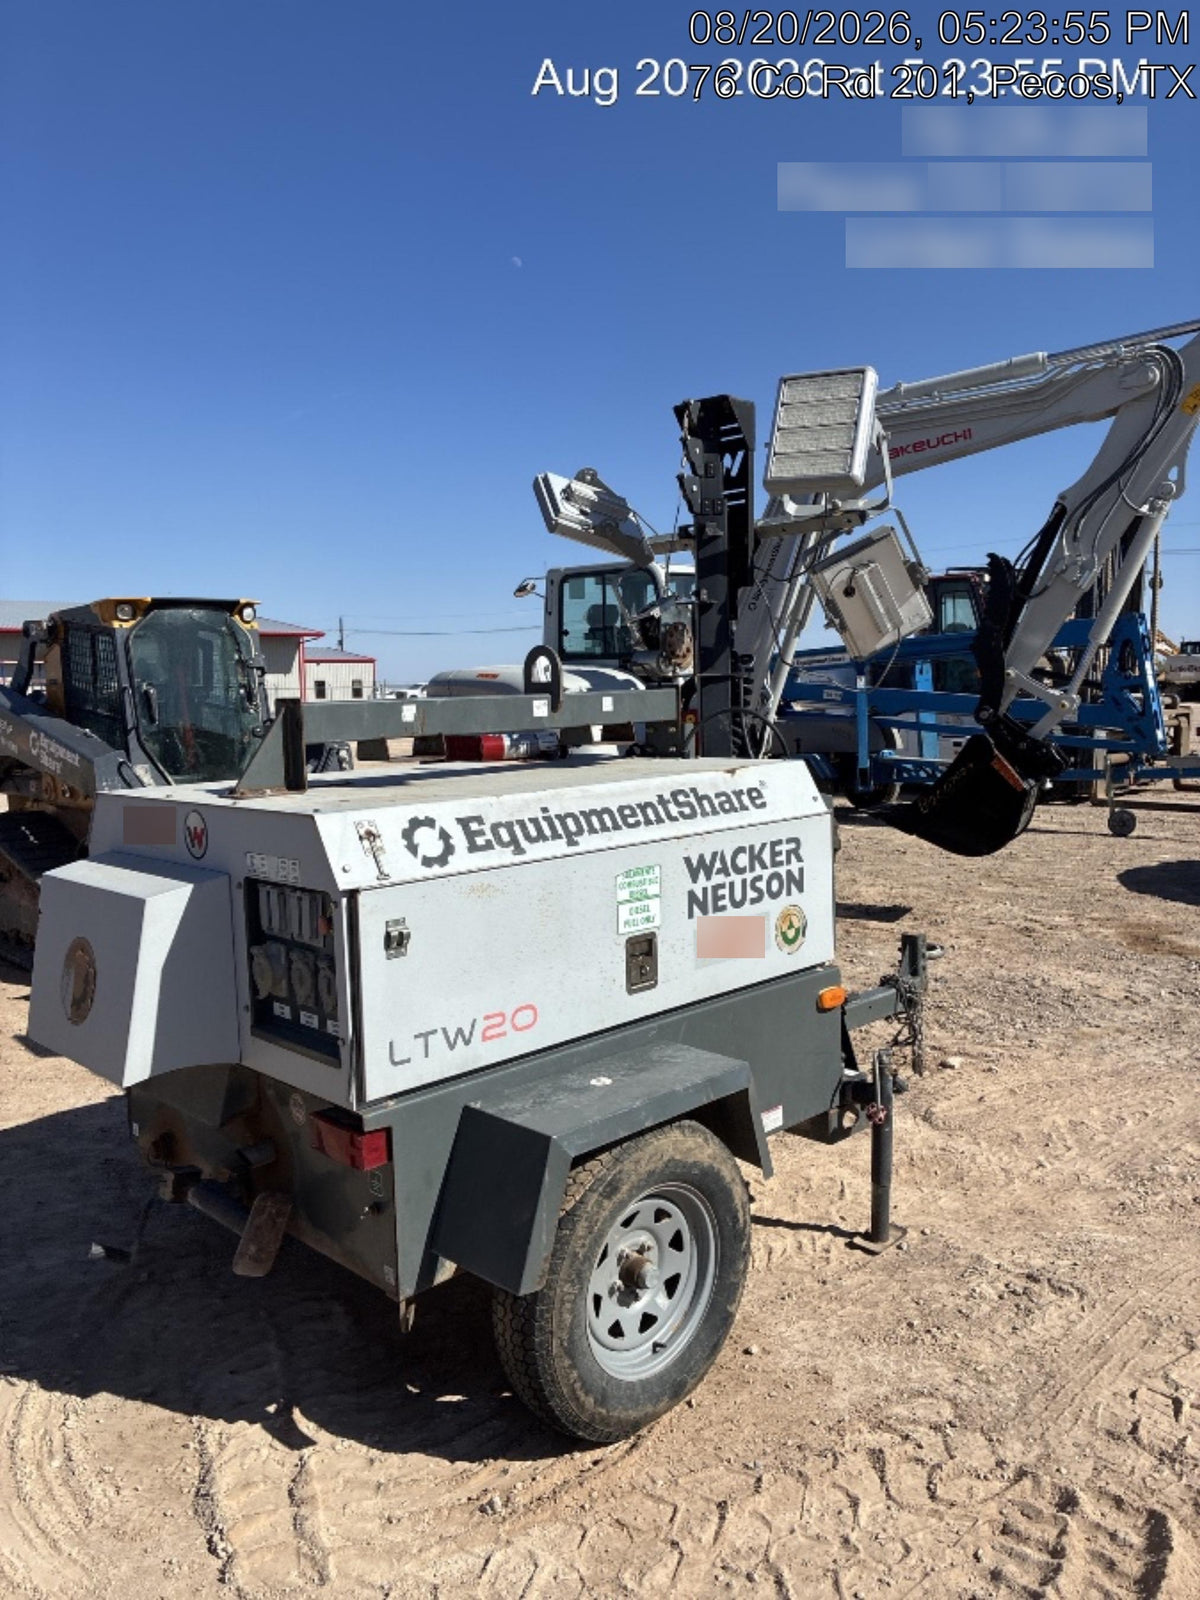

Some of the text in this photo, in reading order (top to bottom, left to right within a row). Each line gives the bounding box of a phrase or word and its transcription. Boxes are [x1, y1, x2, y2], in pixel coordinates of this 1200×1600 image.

[683, 837, 804, 884] WACKER
[687, 867, 804, 919] NEUSON
[389, 1003, 539, 1067] LTW20
